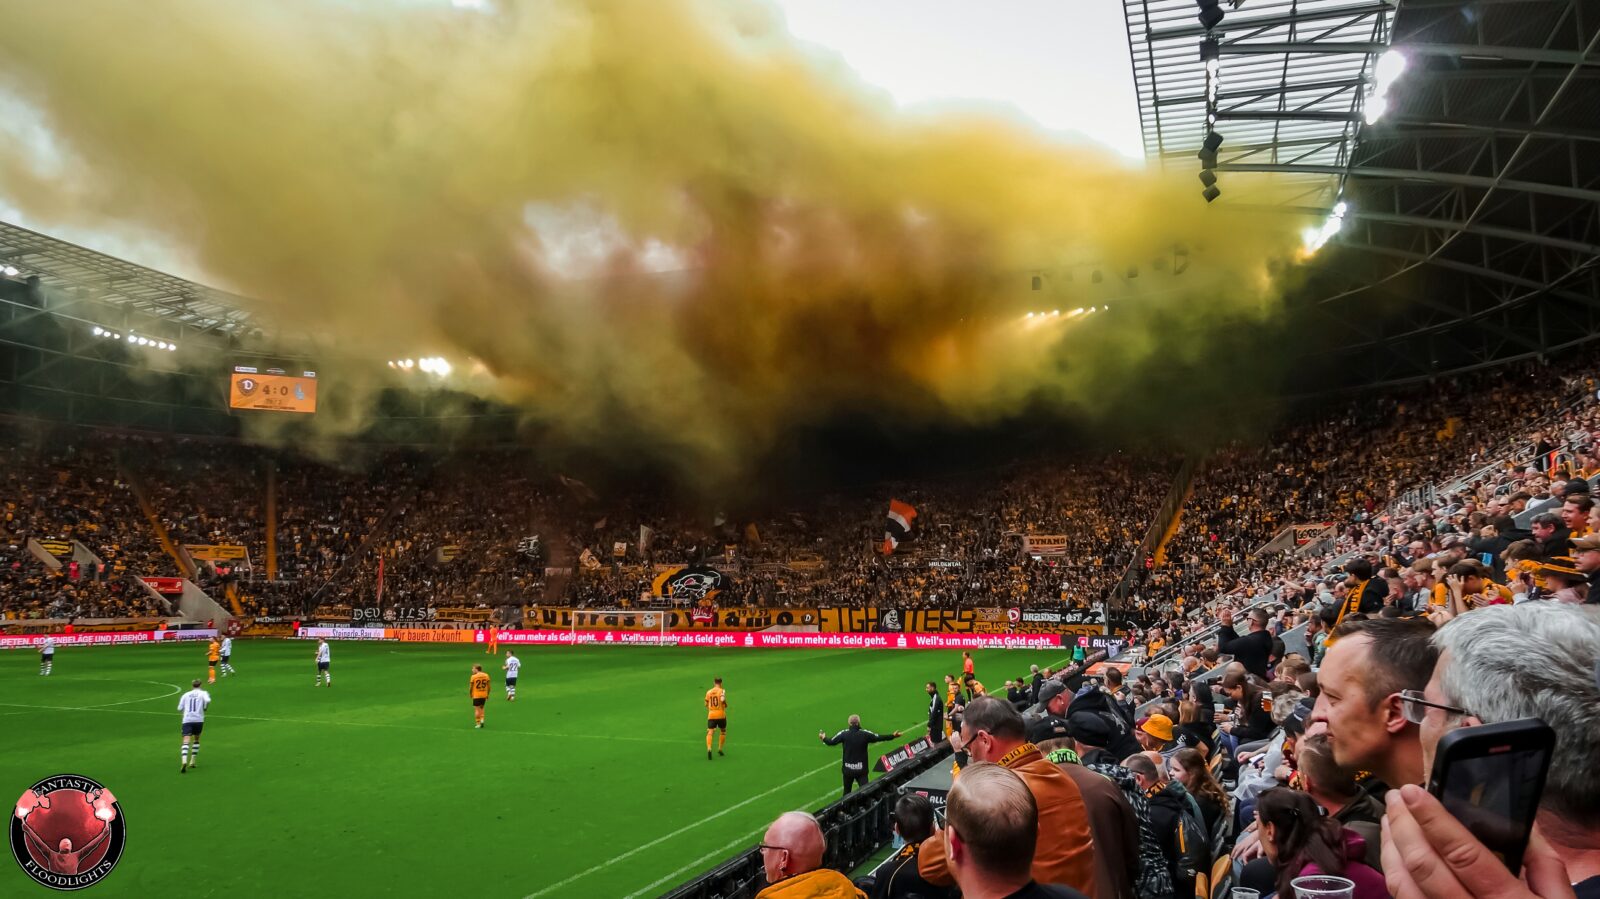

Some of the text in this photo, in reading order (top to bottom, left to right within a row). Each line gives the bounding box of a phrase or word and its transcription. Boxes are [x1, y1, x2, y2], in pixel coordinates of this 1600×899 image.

[95, 634, 111, 643] UND
[113, 633, 148, 642] ZUBEHÖR
[393, 630, 463, 642] Wir bauen Zukunft.
[527, 632, 546, 642] mehr
[547, 633, 559, 642] als
[559, 632, 576, 642] Geld
[577, 633, 597, 644] geht.
[621, 633, 642, 642] Weil's
[661, 633, 680, 644] mehr
[681, 634, 694, 643] als
[695, 634, 713, 643] Geld
[715, 633, 736, 645] geht.
[762, 634, 788, 644] Weil's
[804, 635, 827, 644] mehr
[828, 635, 841, 644] als
[843, 635, 863, 644] Geld
[864, 634, 887, 646] geht.
[916, 636, 944, 646] Weil's
[962, 636, 987, 646] mehr
[988, 637, 1003, 645] als
[1004, 637, 1025, 645] Geld
[1027, 637, 1053, 646] geht.
[509, 663, 518, 671] 22
[476, 679, 487, 689] 25
[189, 698, 196, 712] 11
[710, 696, 719, 707] 10
